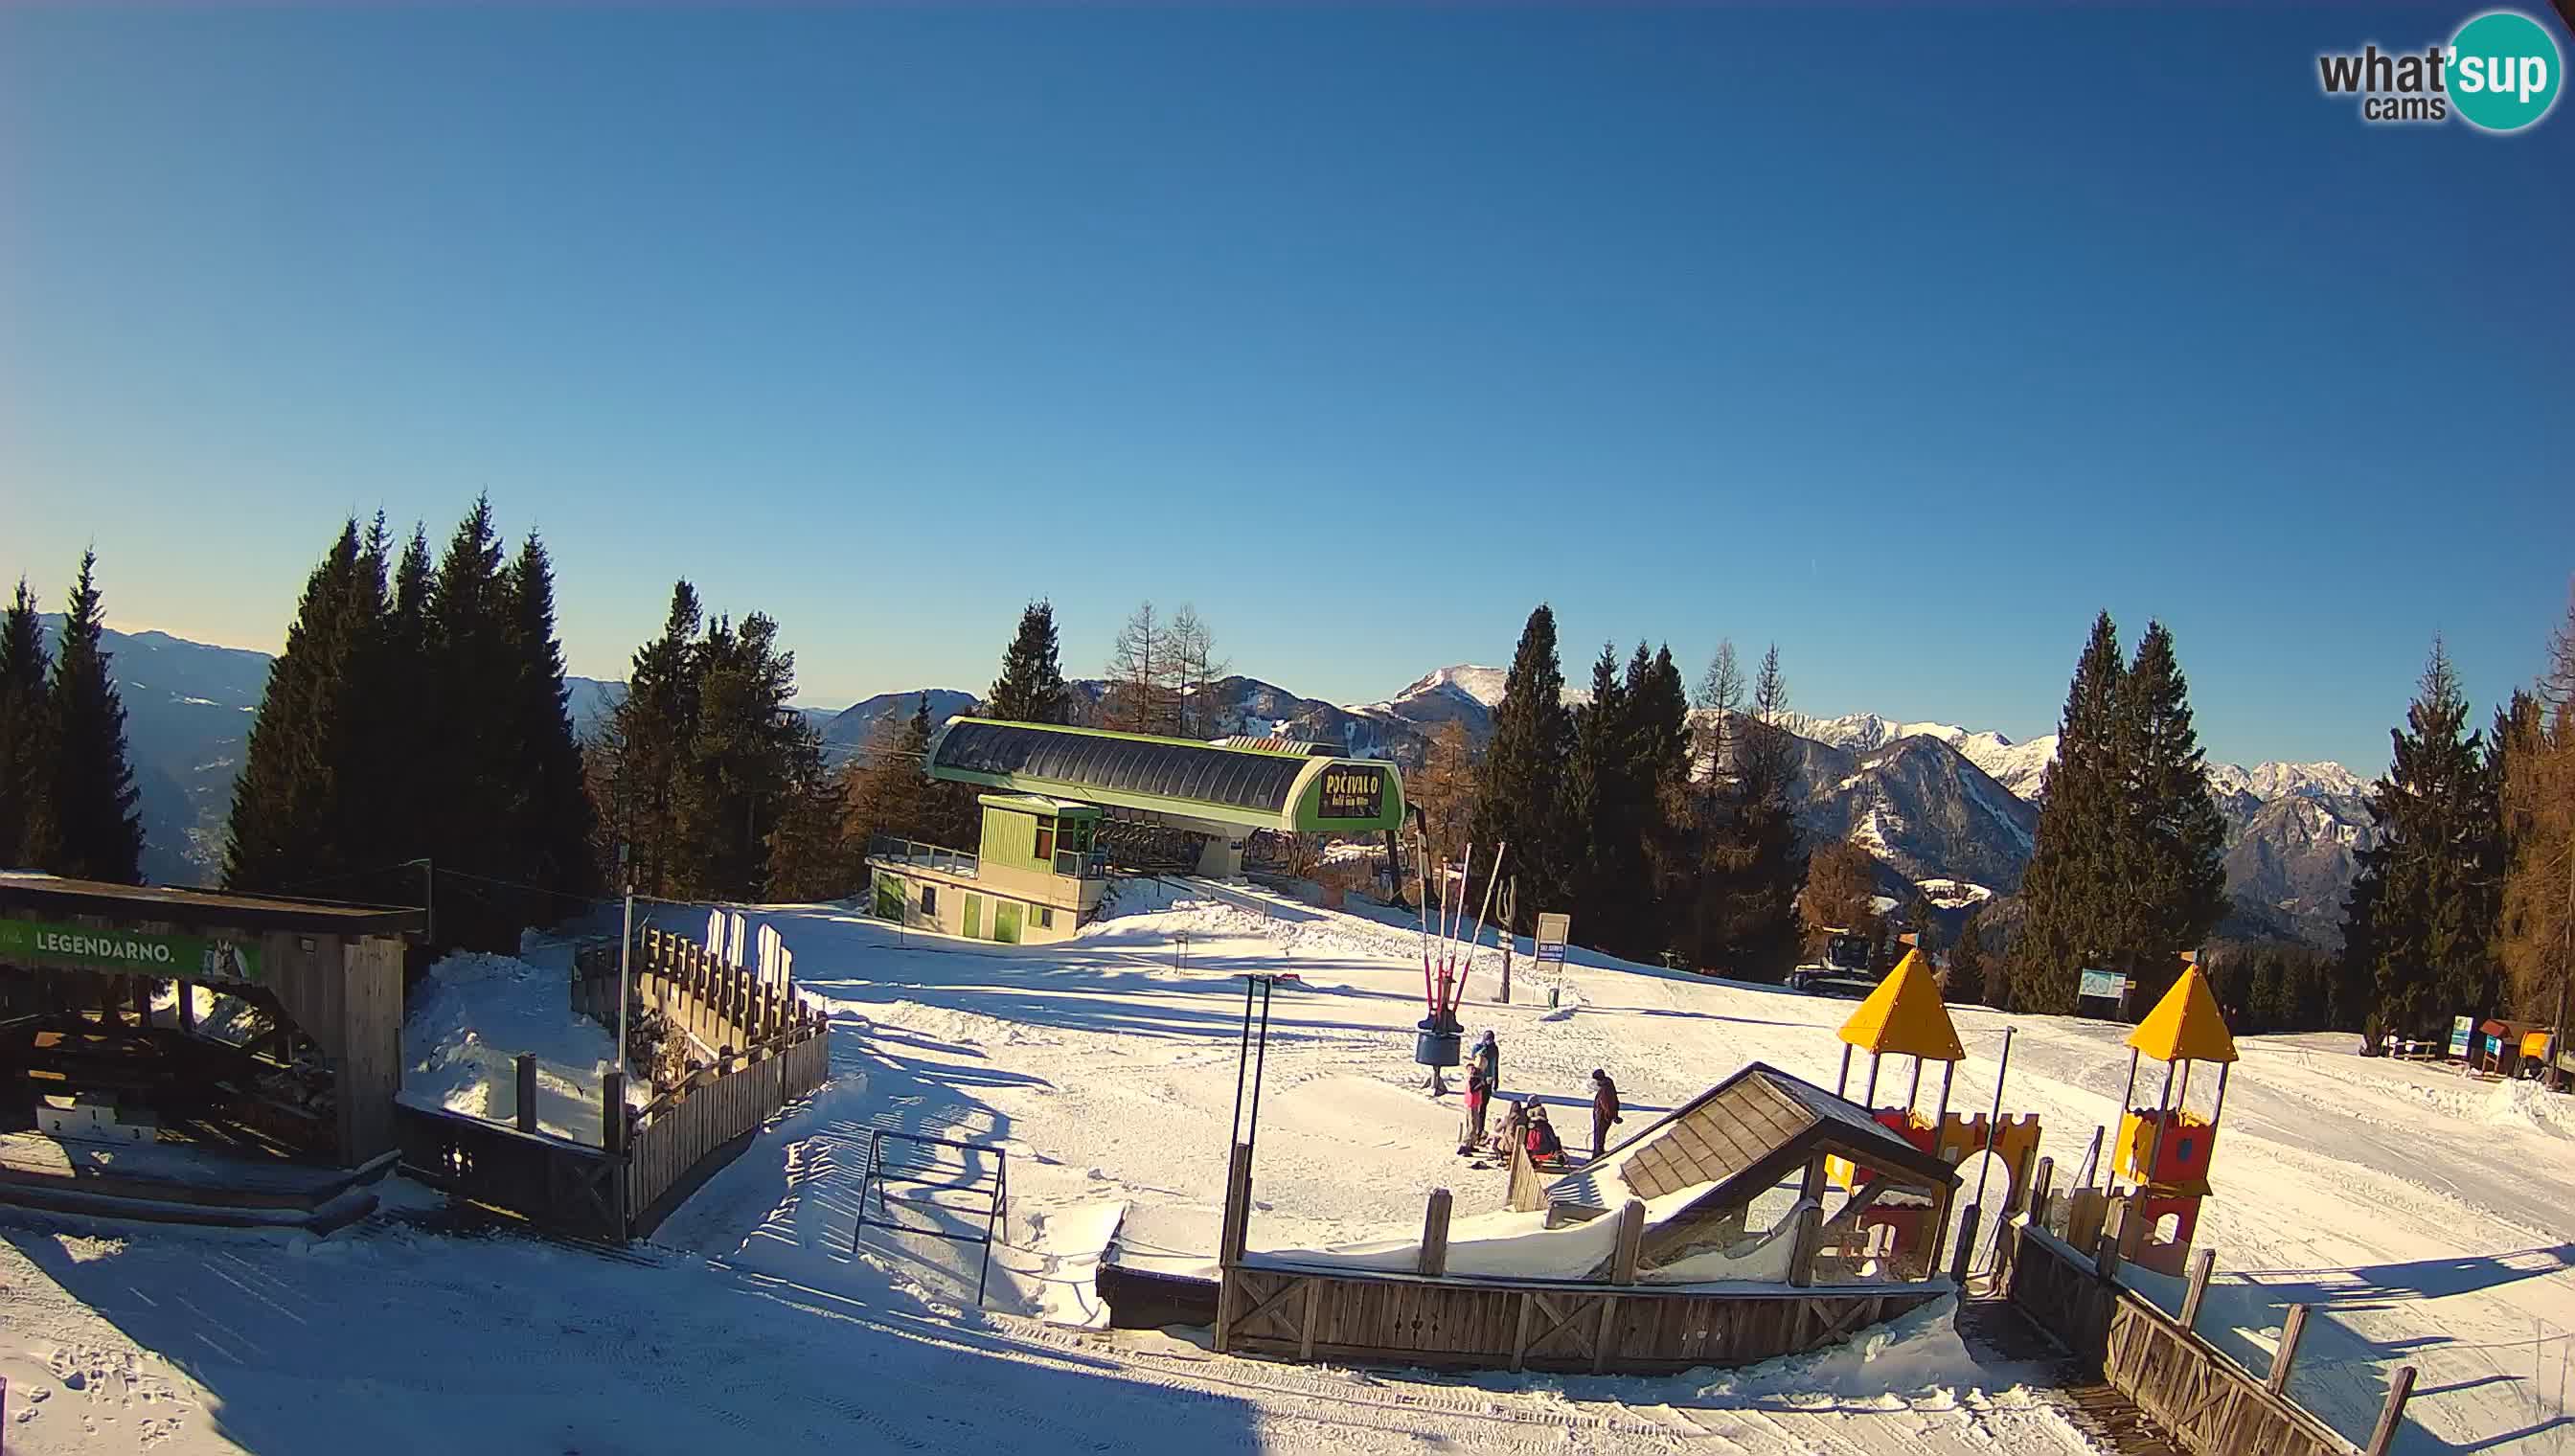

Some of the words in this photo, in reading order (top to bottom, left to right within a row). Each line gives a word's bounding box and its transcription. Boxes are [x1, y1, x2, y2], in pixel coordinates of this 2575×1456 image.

[36, 932, 175, 963] LEGENDARNO.
[54, 1120, 61, 1130] 2
[131, 1128, 140, 1139] 3
